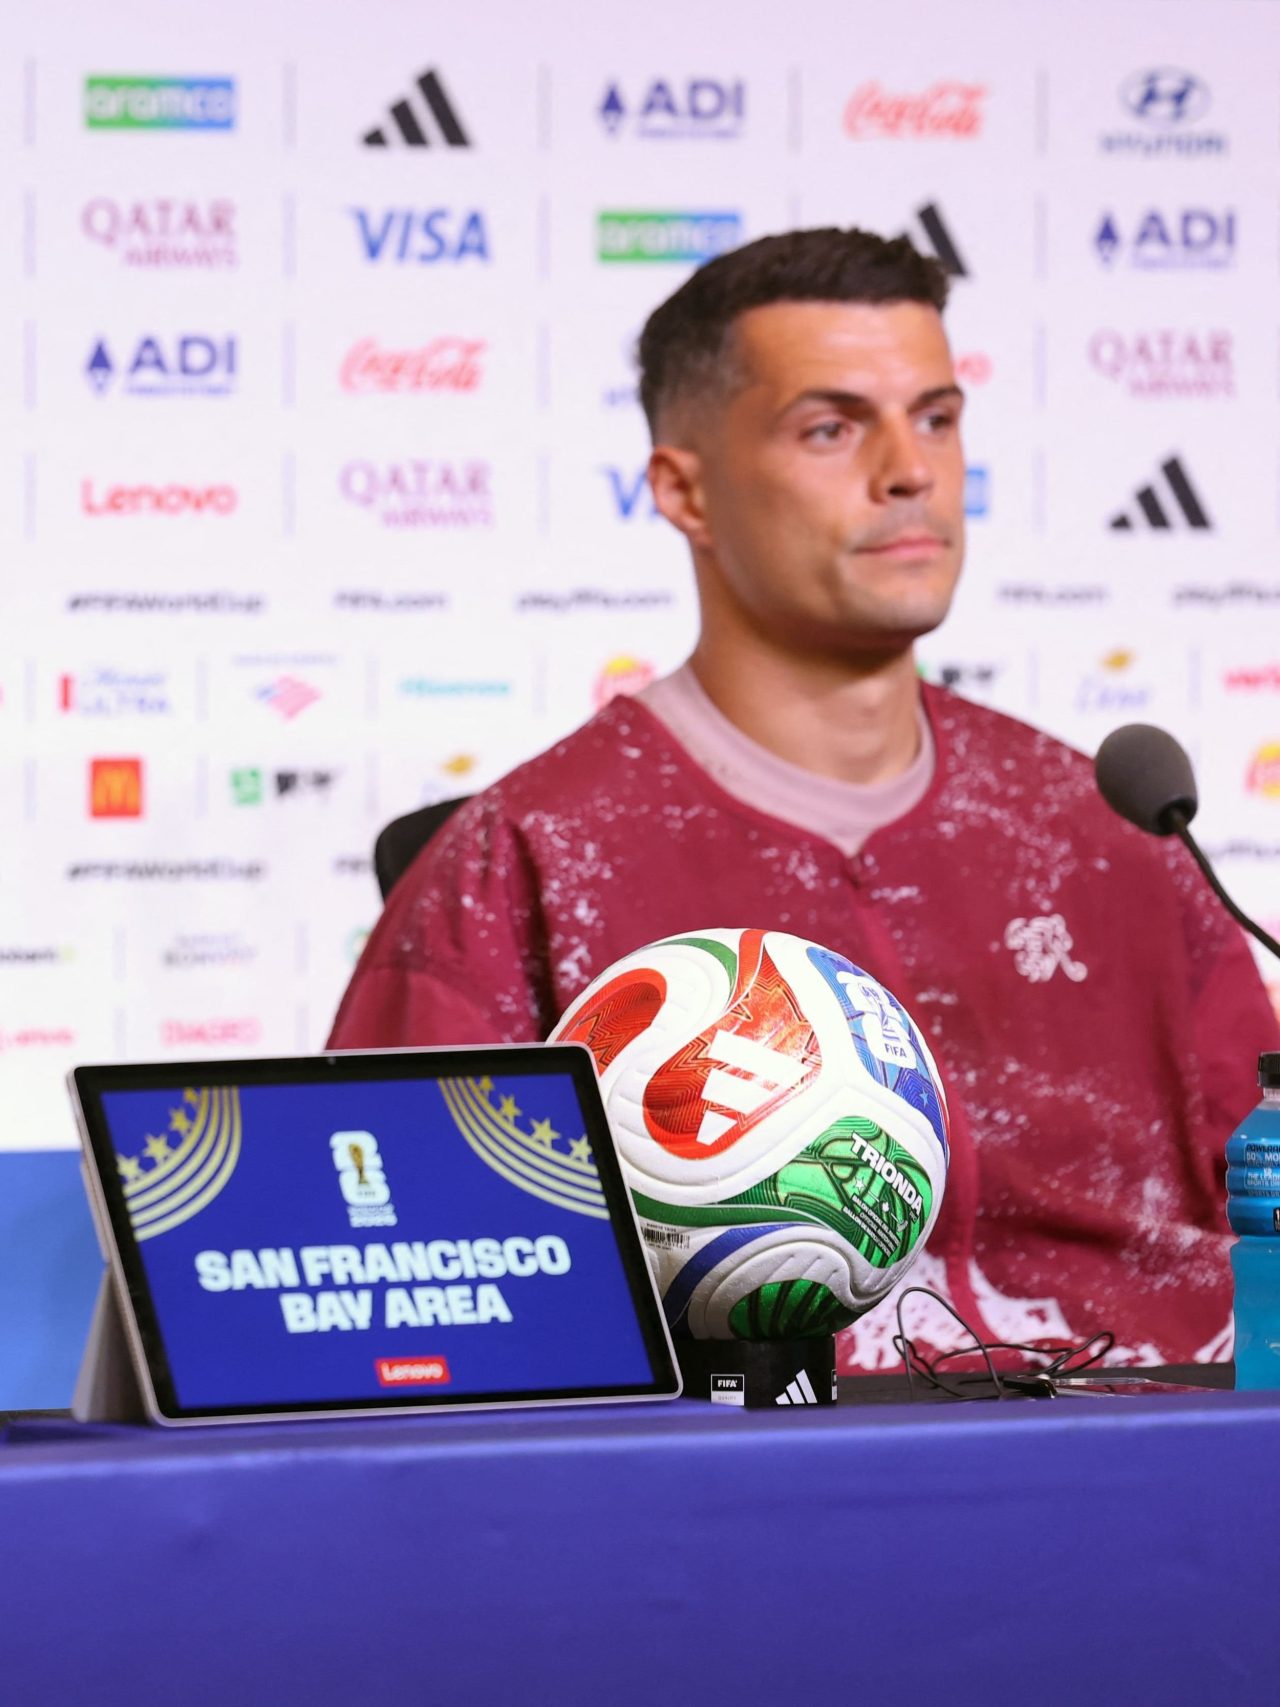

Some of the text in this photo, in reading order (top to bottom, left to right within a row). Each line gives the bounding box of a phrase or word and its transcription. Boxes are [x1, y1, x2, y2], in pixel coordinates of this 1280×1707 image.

[641, 81, 744, 119] ADI
[81, 199, 235, 249] QATAR
[353, 208, 491, 264] VISA
[1135, 210, 1235, 244] ADI
[128, 336, 236, 376] ADI
[1089, 330, 1233, 376] QATAR
[81, 480, 238, 517] Lenovo
[338, 459, 491, 502] QATAR
[884, 1043, 907, 1058] FIFA
[851, 1131, 923, 1217] TRIONDA
[194, 1235, 572, 1292] SAN FRANCISCO
[280, 1284, 513, 1334] BAY AREA
[380, 1361, 444, 1383] Lenovo
